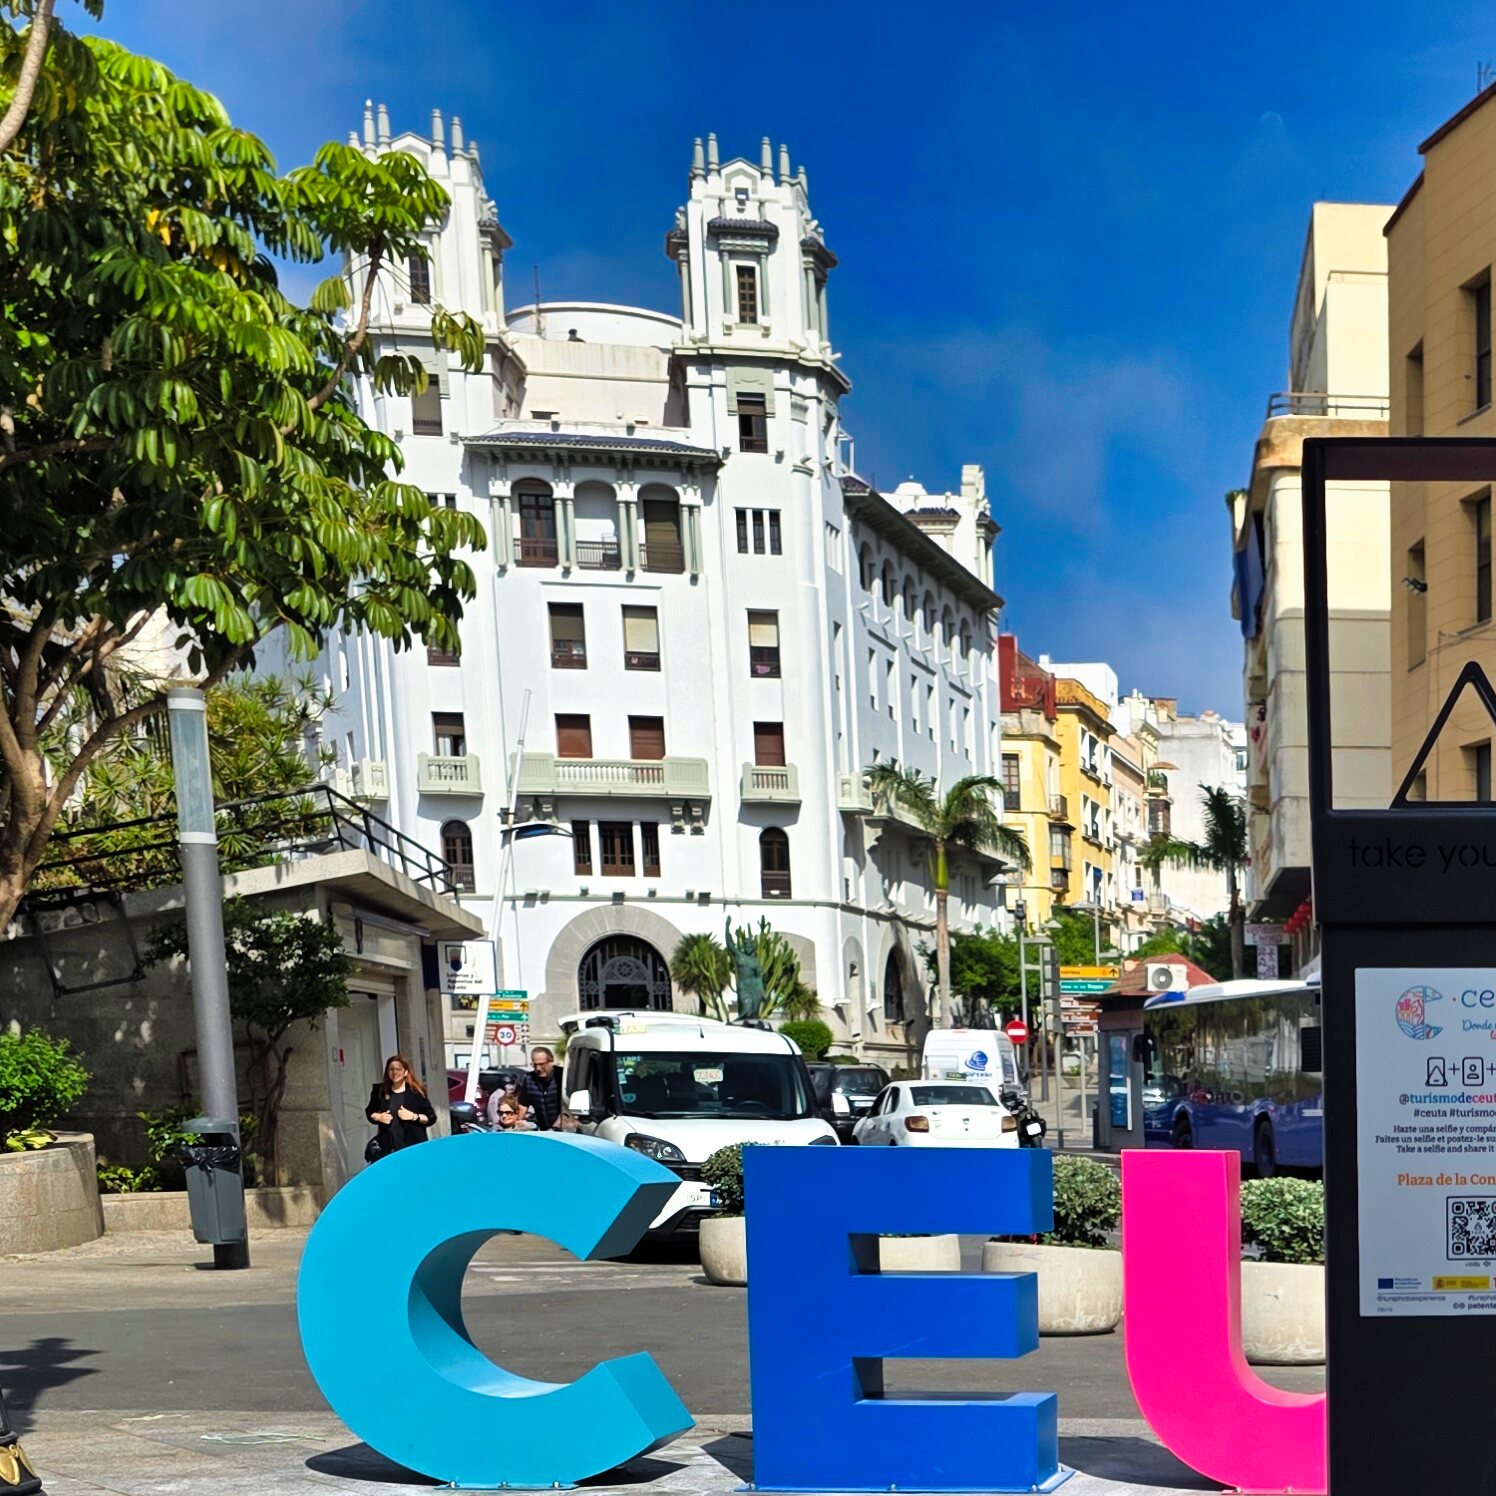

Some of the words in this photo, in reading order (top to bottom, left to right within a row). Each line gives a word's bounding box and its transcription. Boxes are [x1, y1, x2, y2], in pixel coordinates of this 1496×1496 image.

[1349, 838, 1427, 868] take
[1461, 1018, 1493, 1032] Donde
[1413, 1107, 1448, 1118] #ceuta
[1393, 1124, 1418, 1134] Hazte
[1418, 1126, 1434, 1134] una
[1435, 1124, 1459, 1134] selfie
[1459, 1126, 1465, 1135] y
[1375, 1134, 1400, 1144] Faites
[1400, 1136, 1413, 1144] un
[1413, 1134, 1436, 1144] selfie
[1436, 1135, 1445, 1143] et
[1396, 1144, 1416, 1154] Take
[1423, 1144, 1446, 1153] selfie
[1446, 1144, 1464, 1153] and
[1463, 1143, 1488, 1153] share
[1488, 1143, 1495, 1153] it
[1397, 1172, 1434, 1187] Plaza
[1435, 1172, 1453, 1186] de
[1454, 1172, 1468, 1186] la
